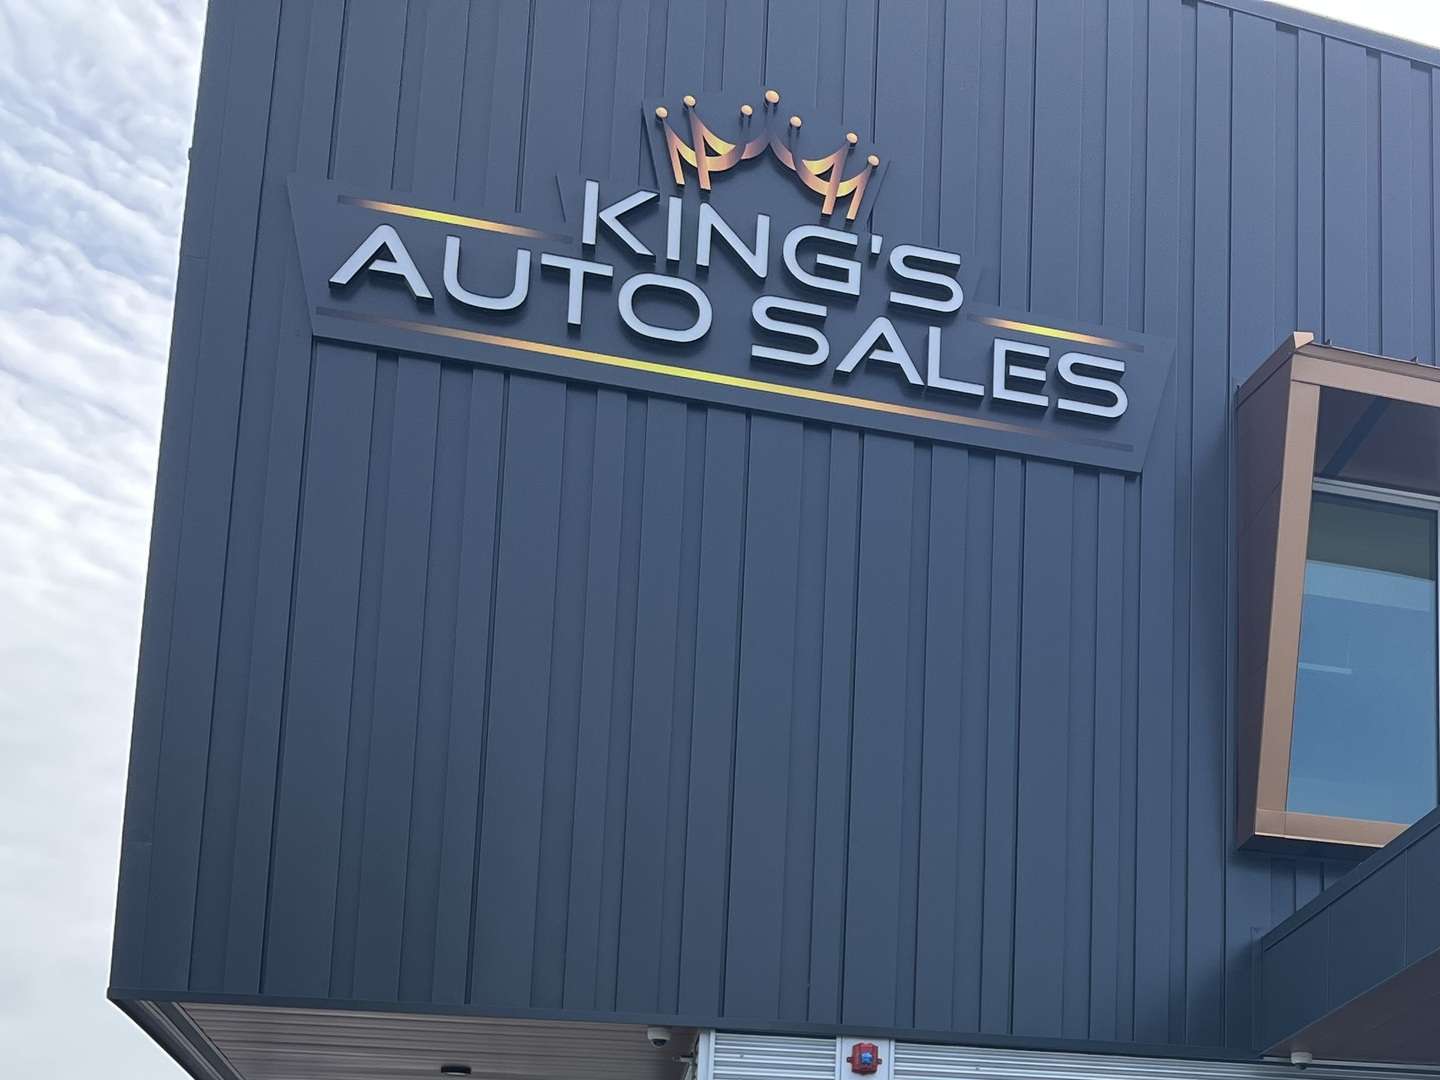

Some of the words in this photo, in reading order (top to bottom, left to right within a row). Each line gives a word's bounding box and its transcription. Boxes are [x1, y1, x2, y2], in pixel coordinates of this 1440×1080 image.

[328, 224, 713, 343] AUTO
[752, 295, 1128, 418] SALES
[582, 180, 963, 313] KING'S
